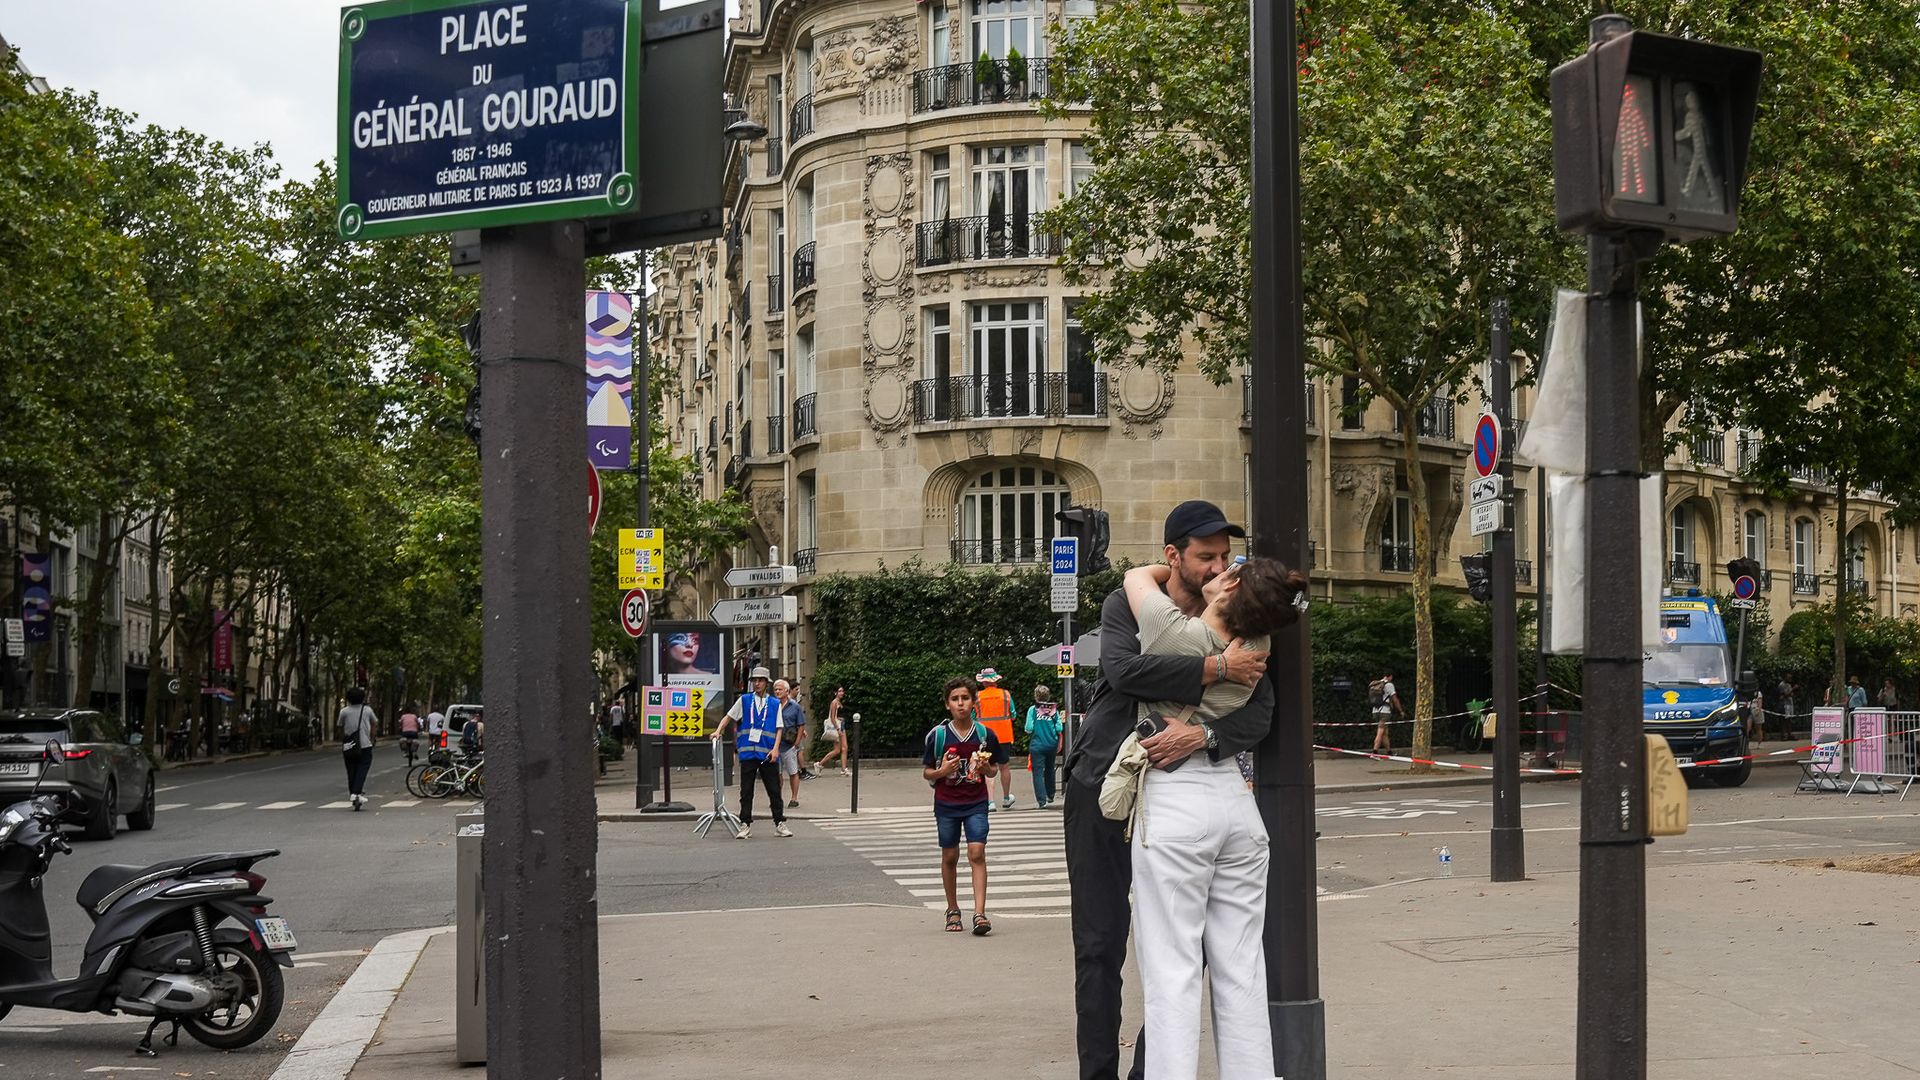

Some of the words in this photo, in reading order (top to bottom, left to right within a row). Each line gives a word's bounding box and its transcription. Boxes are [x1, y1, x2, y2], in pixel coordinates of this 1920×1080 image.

[440, 4, 528, 55] PLACE
[472, 63, 492, 86] DU
[353, 95, 472, 149] GÉNÉRAL
[482, 77, 617, 133] GOURAUD
[451, 146, 476, 163] 1867
[486, 142, 512, 159] 1946
[436, 163, 477, 186] GÉNÉRAL
[480, 161, 527, 181] FRANÇAIS
[368, 194, 427, 215] GOUVERNEUR
[429, 189, 472, 209] MILITAIRE
[474, 187, 487, 203] DE
[489, 183, 517, 200] PARIS
[520, 181, 533, 197] DE
[535, 179, 562, 195] 1923
[565, 174, 573, 192] À
[575, 173, 602, 191] 1937
[1054, 545, 1074, 554] PARIS
[1055, 560, 1073, 569] 2024
[749, 571, 781, 581] INVALIDES
[628, 602, 644, 624] 30
[744, 603, 760, 611] Place
[763, 602, 770, 610] de
[755, 612, 781, 621] Militaire
[650, 694, 660, 702] TC
[1653, 710, 1691, 720] IVECO
